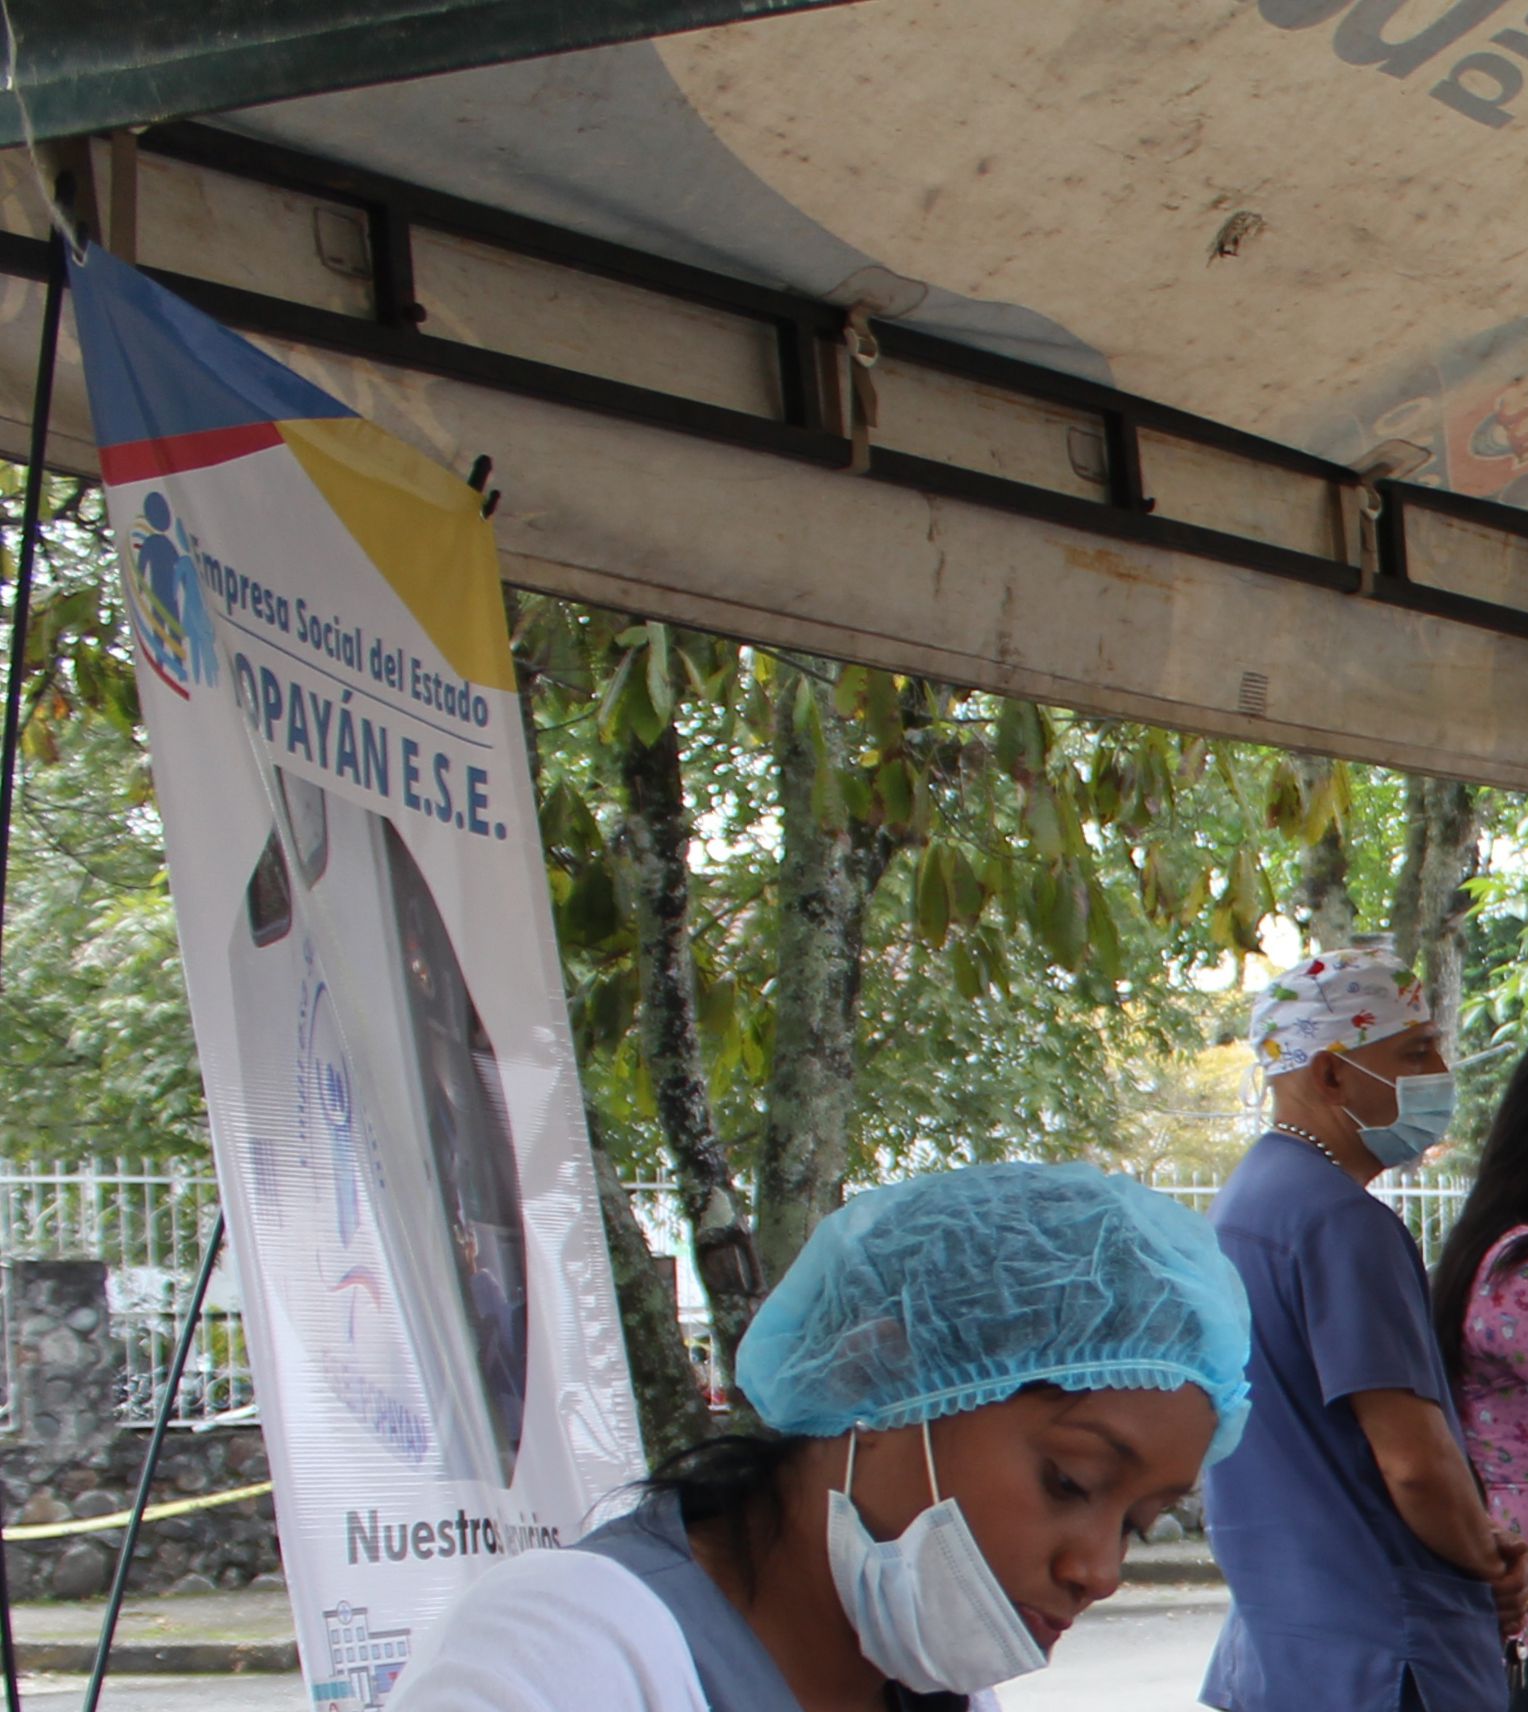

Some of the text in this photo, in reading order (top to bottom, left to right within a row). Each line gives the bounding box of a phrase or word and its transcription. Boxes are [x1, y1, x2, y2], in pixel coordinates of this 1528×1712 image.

[295, 597, 363, 673] Social
[369, 638, 404, 692] del
[410, 656, 489, 728] Estado
[401, 735, 508, 842] E.S.E.
